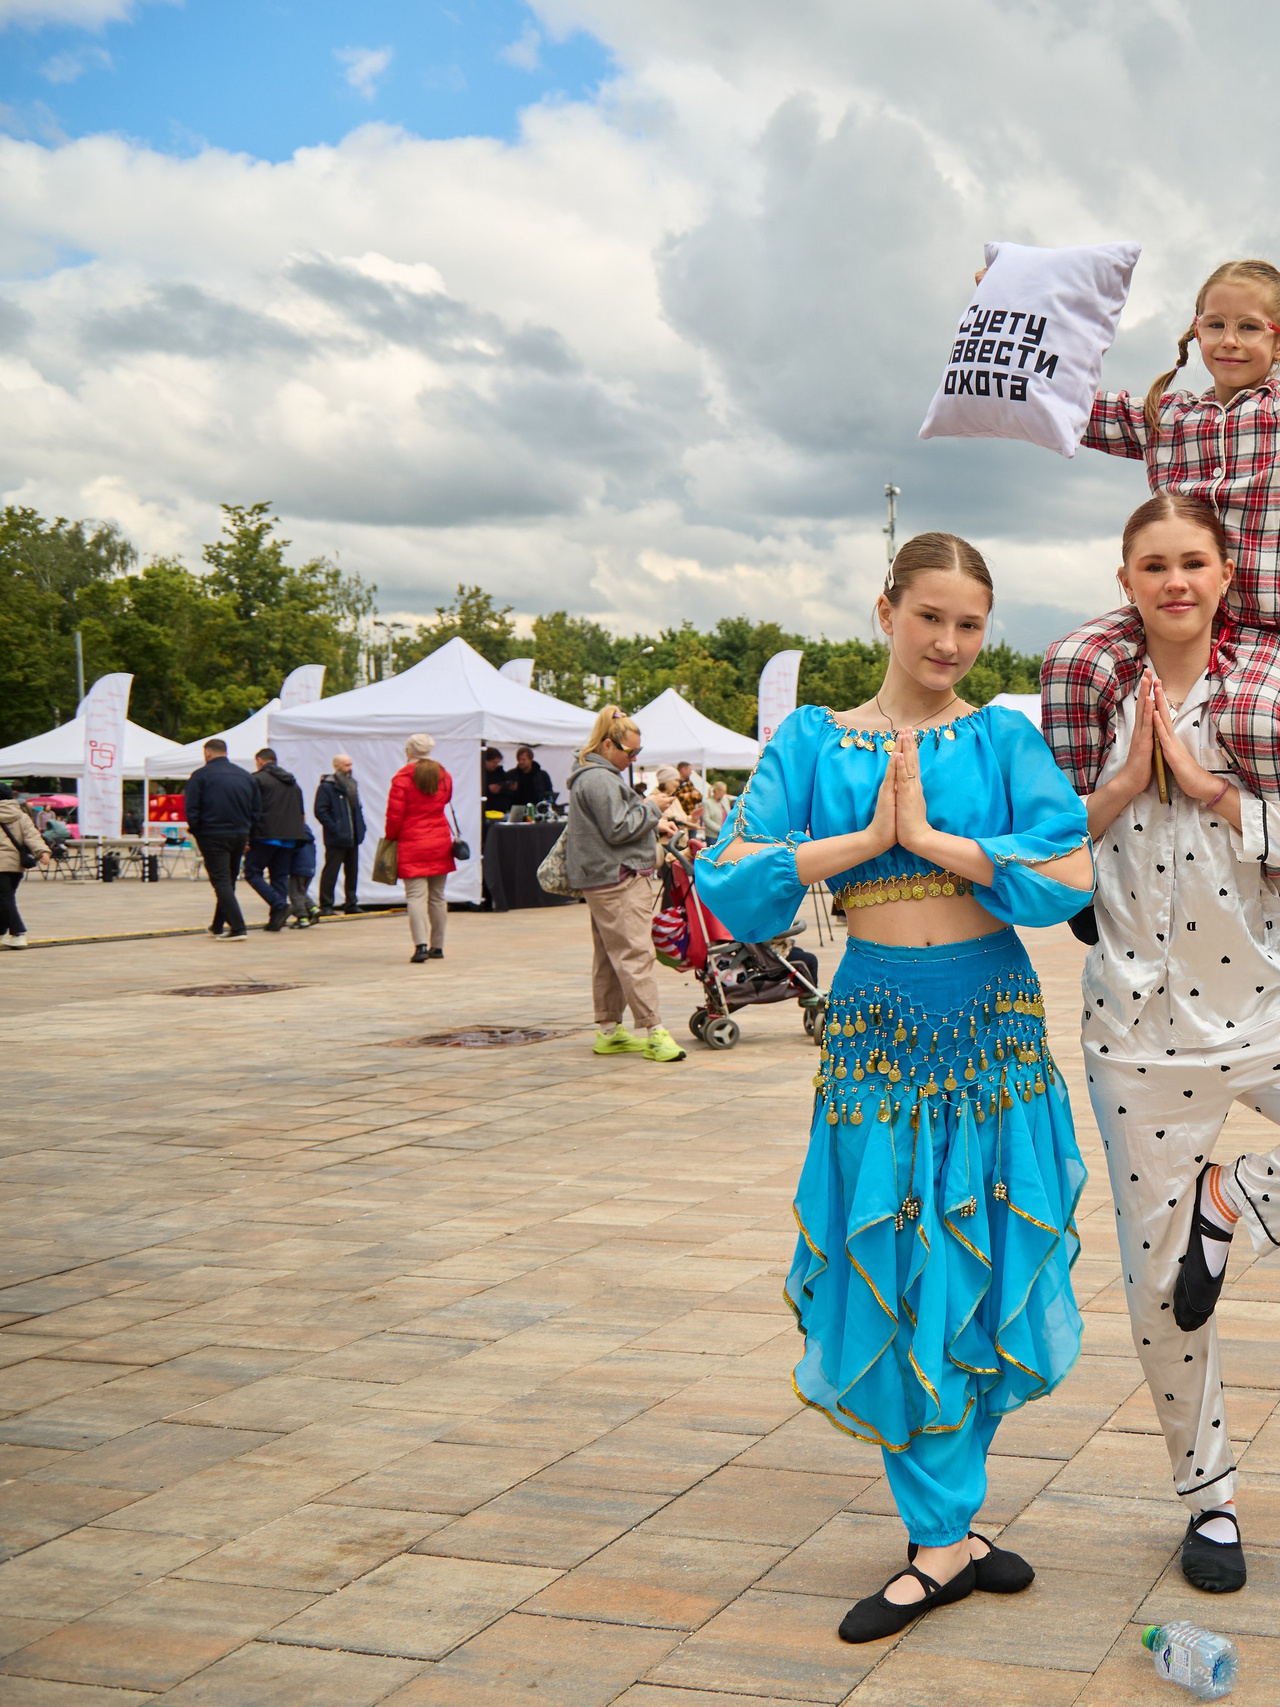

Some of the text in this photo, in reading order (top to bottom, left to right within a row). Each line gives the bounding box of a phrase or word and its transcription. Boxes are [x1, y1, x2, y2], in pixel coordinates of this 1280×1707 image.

[959, 304, 1047, 346] Суету
[948, 339, 1059, 380] авести
[944, 369, 1030, 402] охота
